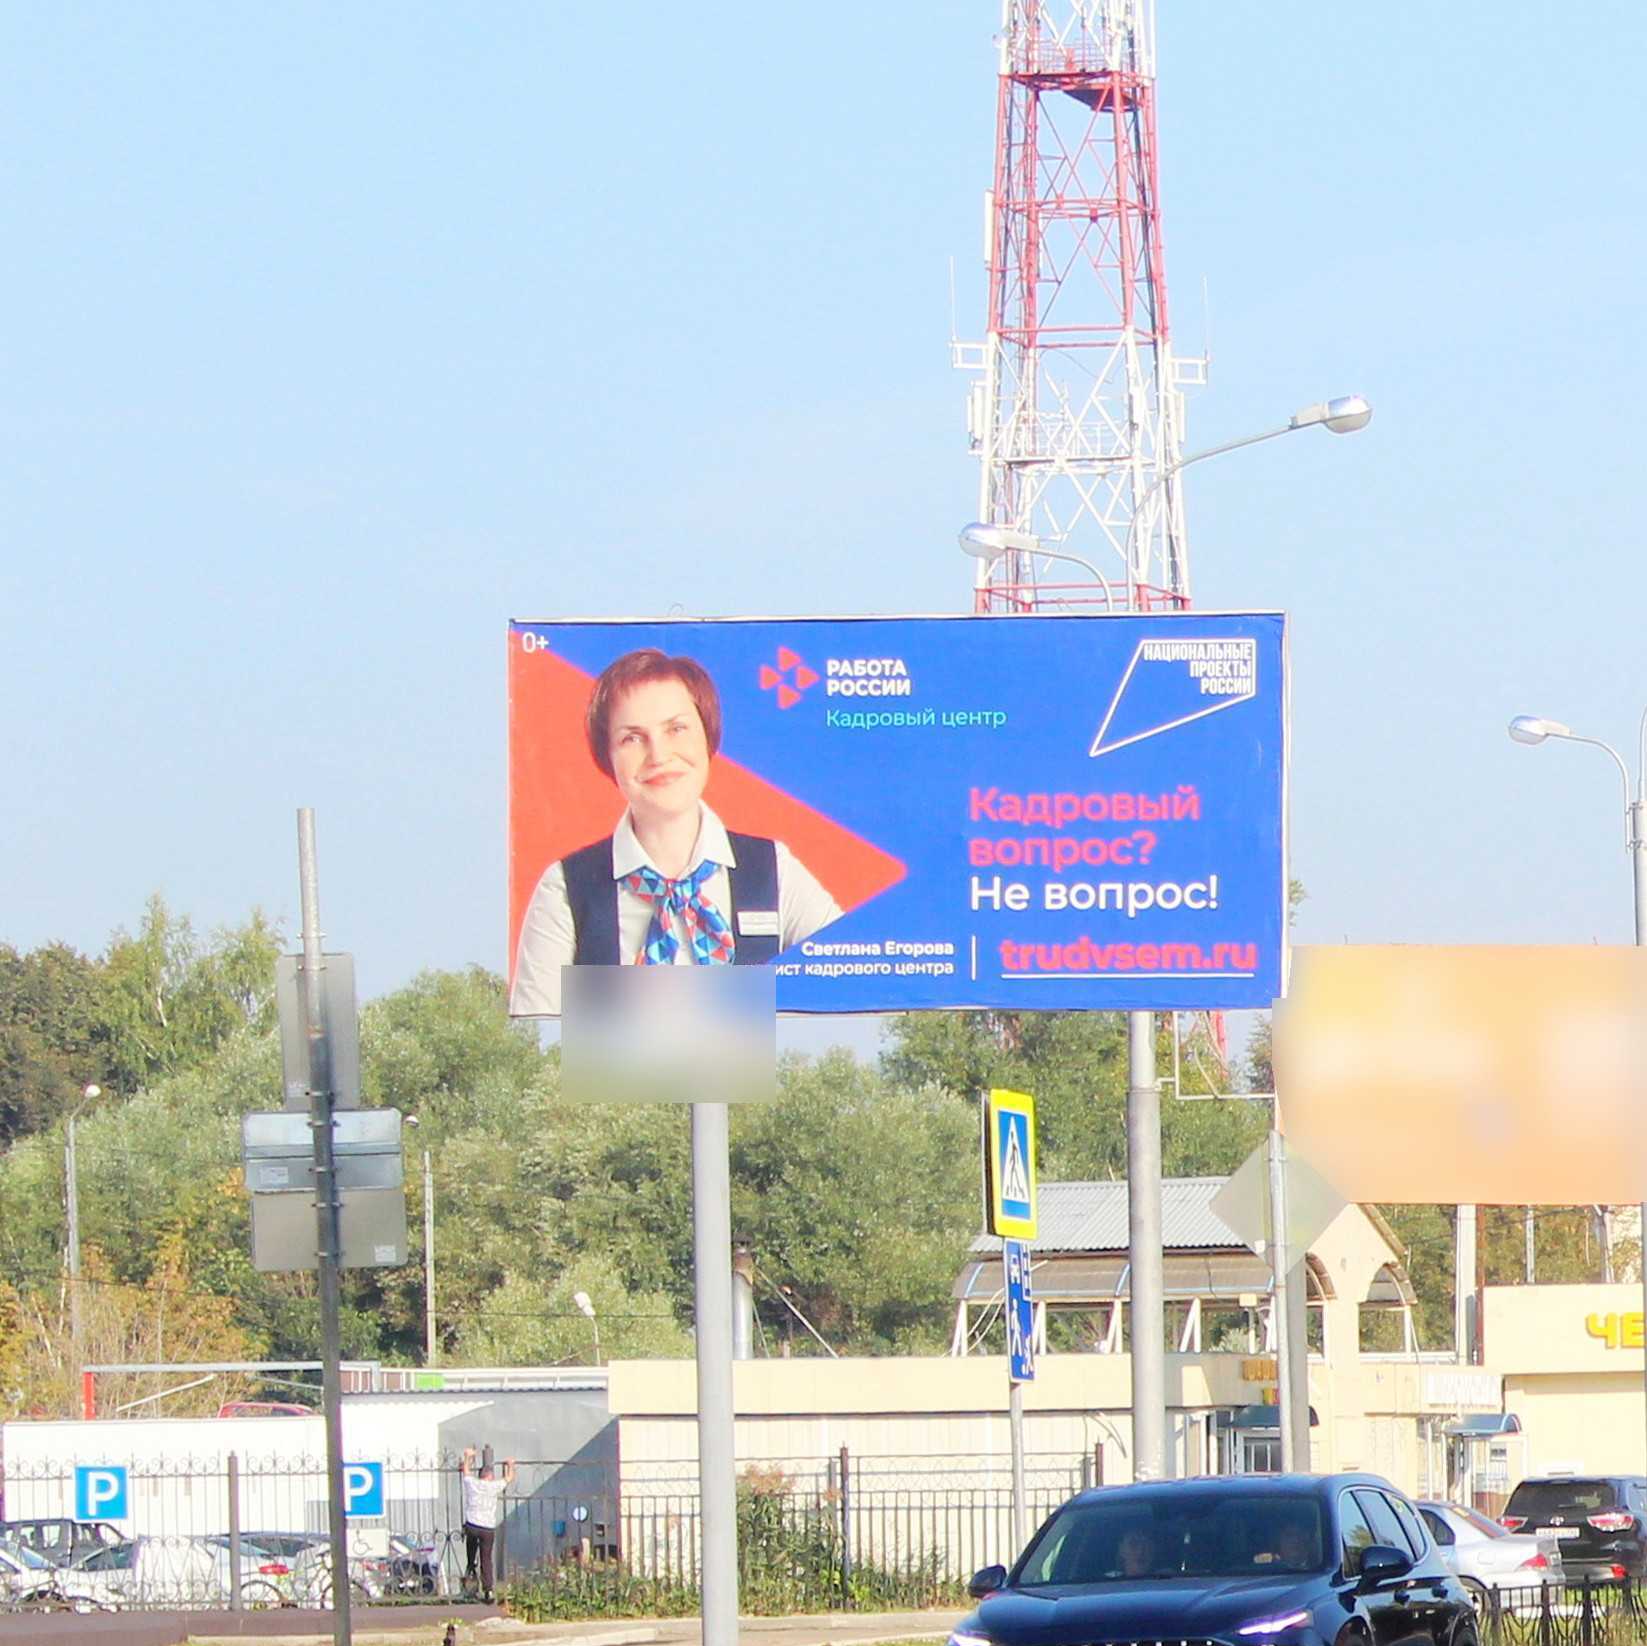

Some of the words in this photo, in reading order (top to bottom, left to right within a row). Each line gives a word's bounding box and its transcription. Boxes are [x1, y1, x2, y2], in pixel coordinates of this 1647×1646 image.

[522, 631, 549, 653] 0+
[1143, 643, 1253, 661] НАЦИОНАЛЬНЫЕ
[826, 659, 907, 677] РАБОТА
[1188, 661, 1253, 678] ПРОЕКТЫ
[826, 678, 911, 697] РОССИИ
[1200, 677, 1253, 695] РОССИИ
[826, 707, 934, 729] Кадровый
[942, 709, 1008, 729] центр
[968, 784, 1201, 829] Кадровый
[968, 830, 1157, 873] вопрос?
[970, 875, 1031, 911] Не
[1044, 874, 1219, 918] вопрос!
[801, 941, 881, 957] Светлана
[884, 941, 955, 958] Егорова
[998, 935, 1259, 971] trudvsem.ru
[805, 963, 891, 978] кадрового
[895, 963, 955, 977] центра
[88, 1471, 119, 1516] P
[344, 1466, 374, 1512] P
